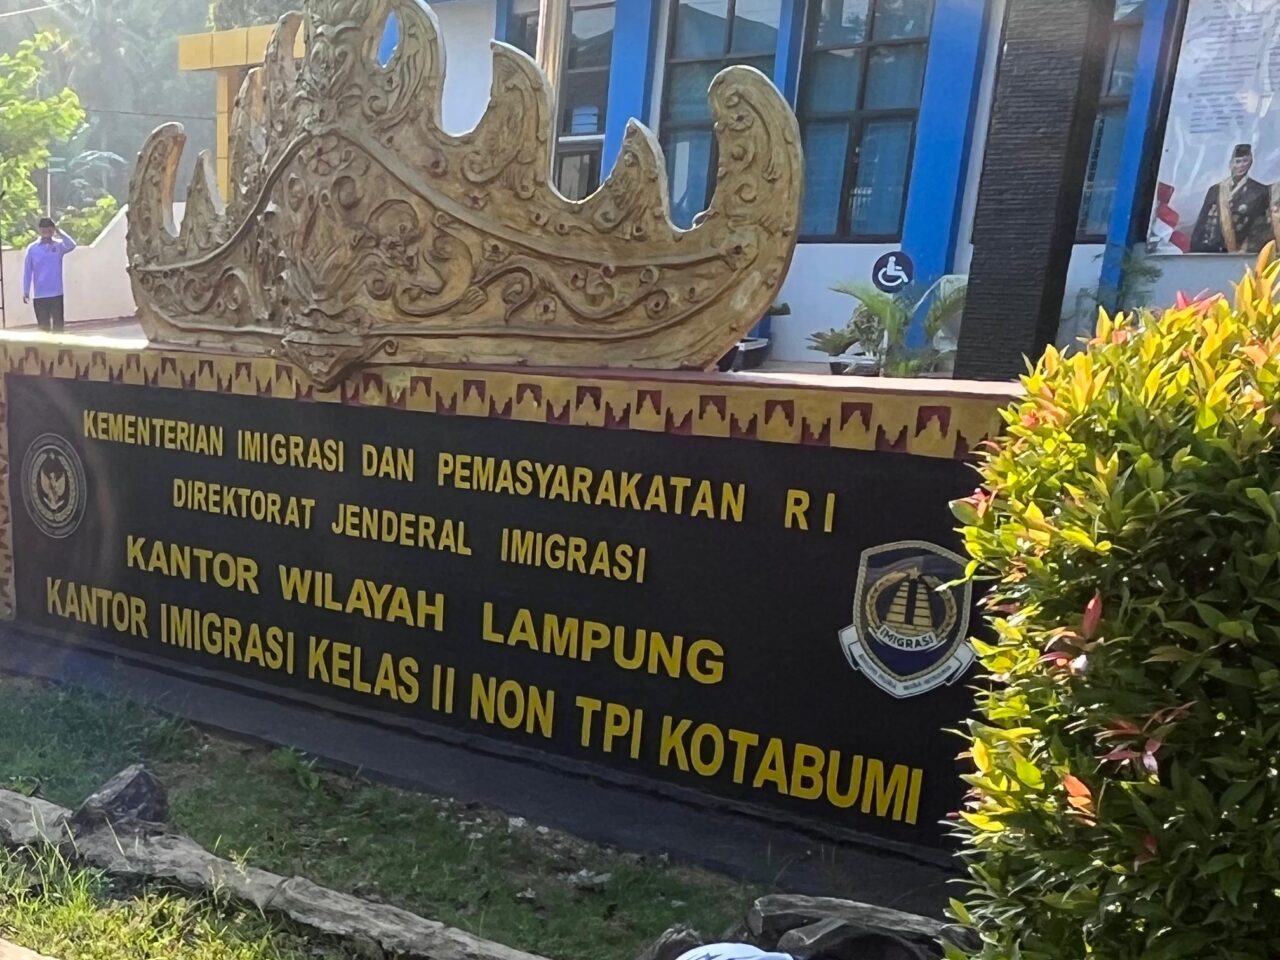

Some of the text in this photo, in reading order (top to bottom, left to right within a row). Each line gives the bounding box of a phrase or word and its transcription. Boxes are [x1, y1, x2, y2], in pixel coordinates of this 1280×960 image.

[84, 410, 223, 457] KEMENTERIAN
[238, 429, 345, 473] IMIGRASI
[362, 444, 415, 482] DAN
[437, 452, 746, 523] PEMASYARAKATAN
[173, 478, 646, 583] DIREKTORAT JENDERAL IMIGRASI
[126, 534, 726, 685] KANTOR WILAYAH LAMPUNG
[880, 627, 934, 649] IMIGRASI
[46, 576, 924, 826] KANTOR IMIGRASI KELAS II NON TPI KOTABUMI
